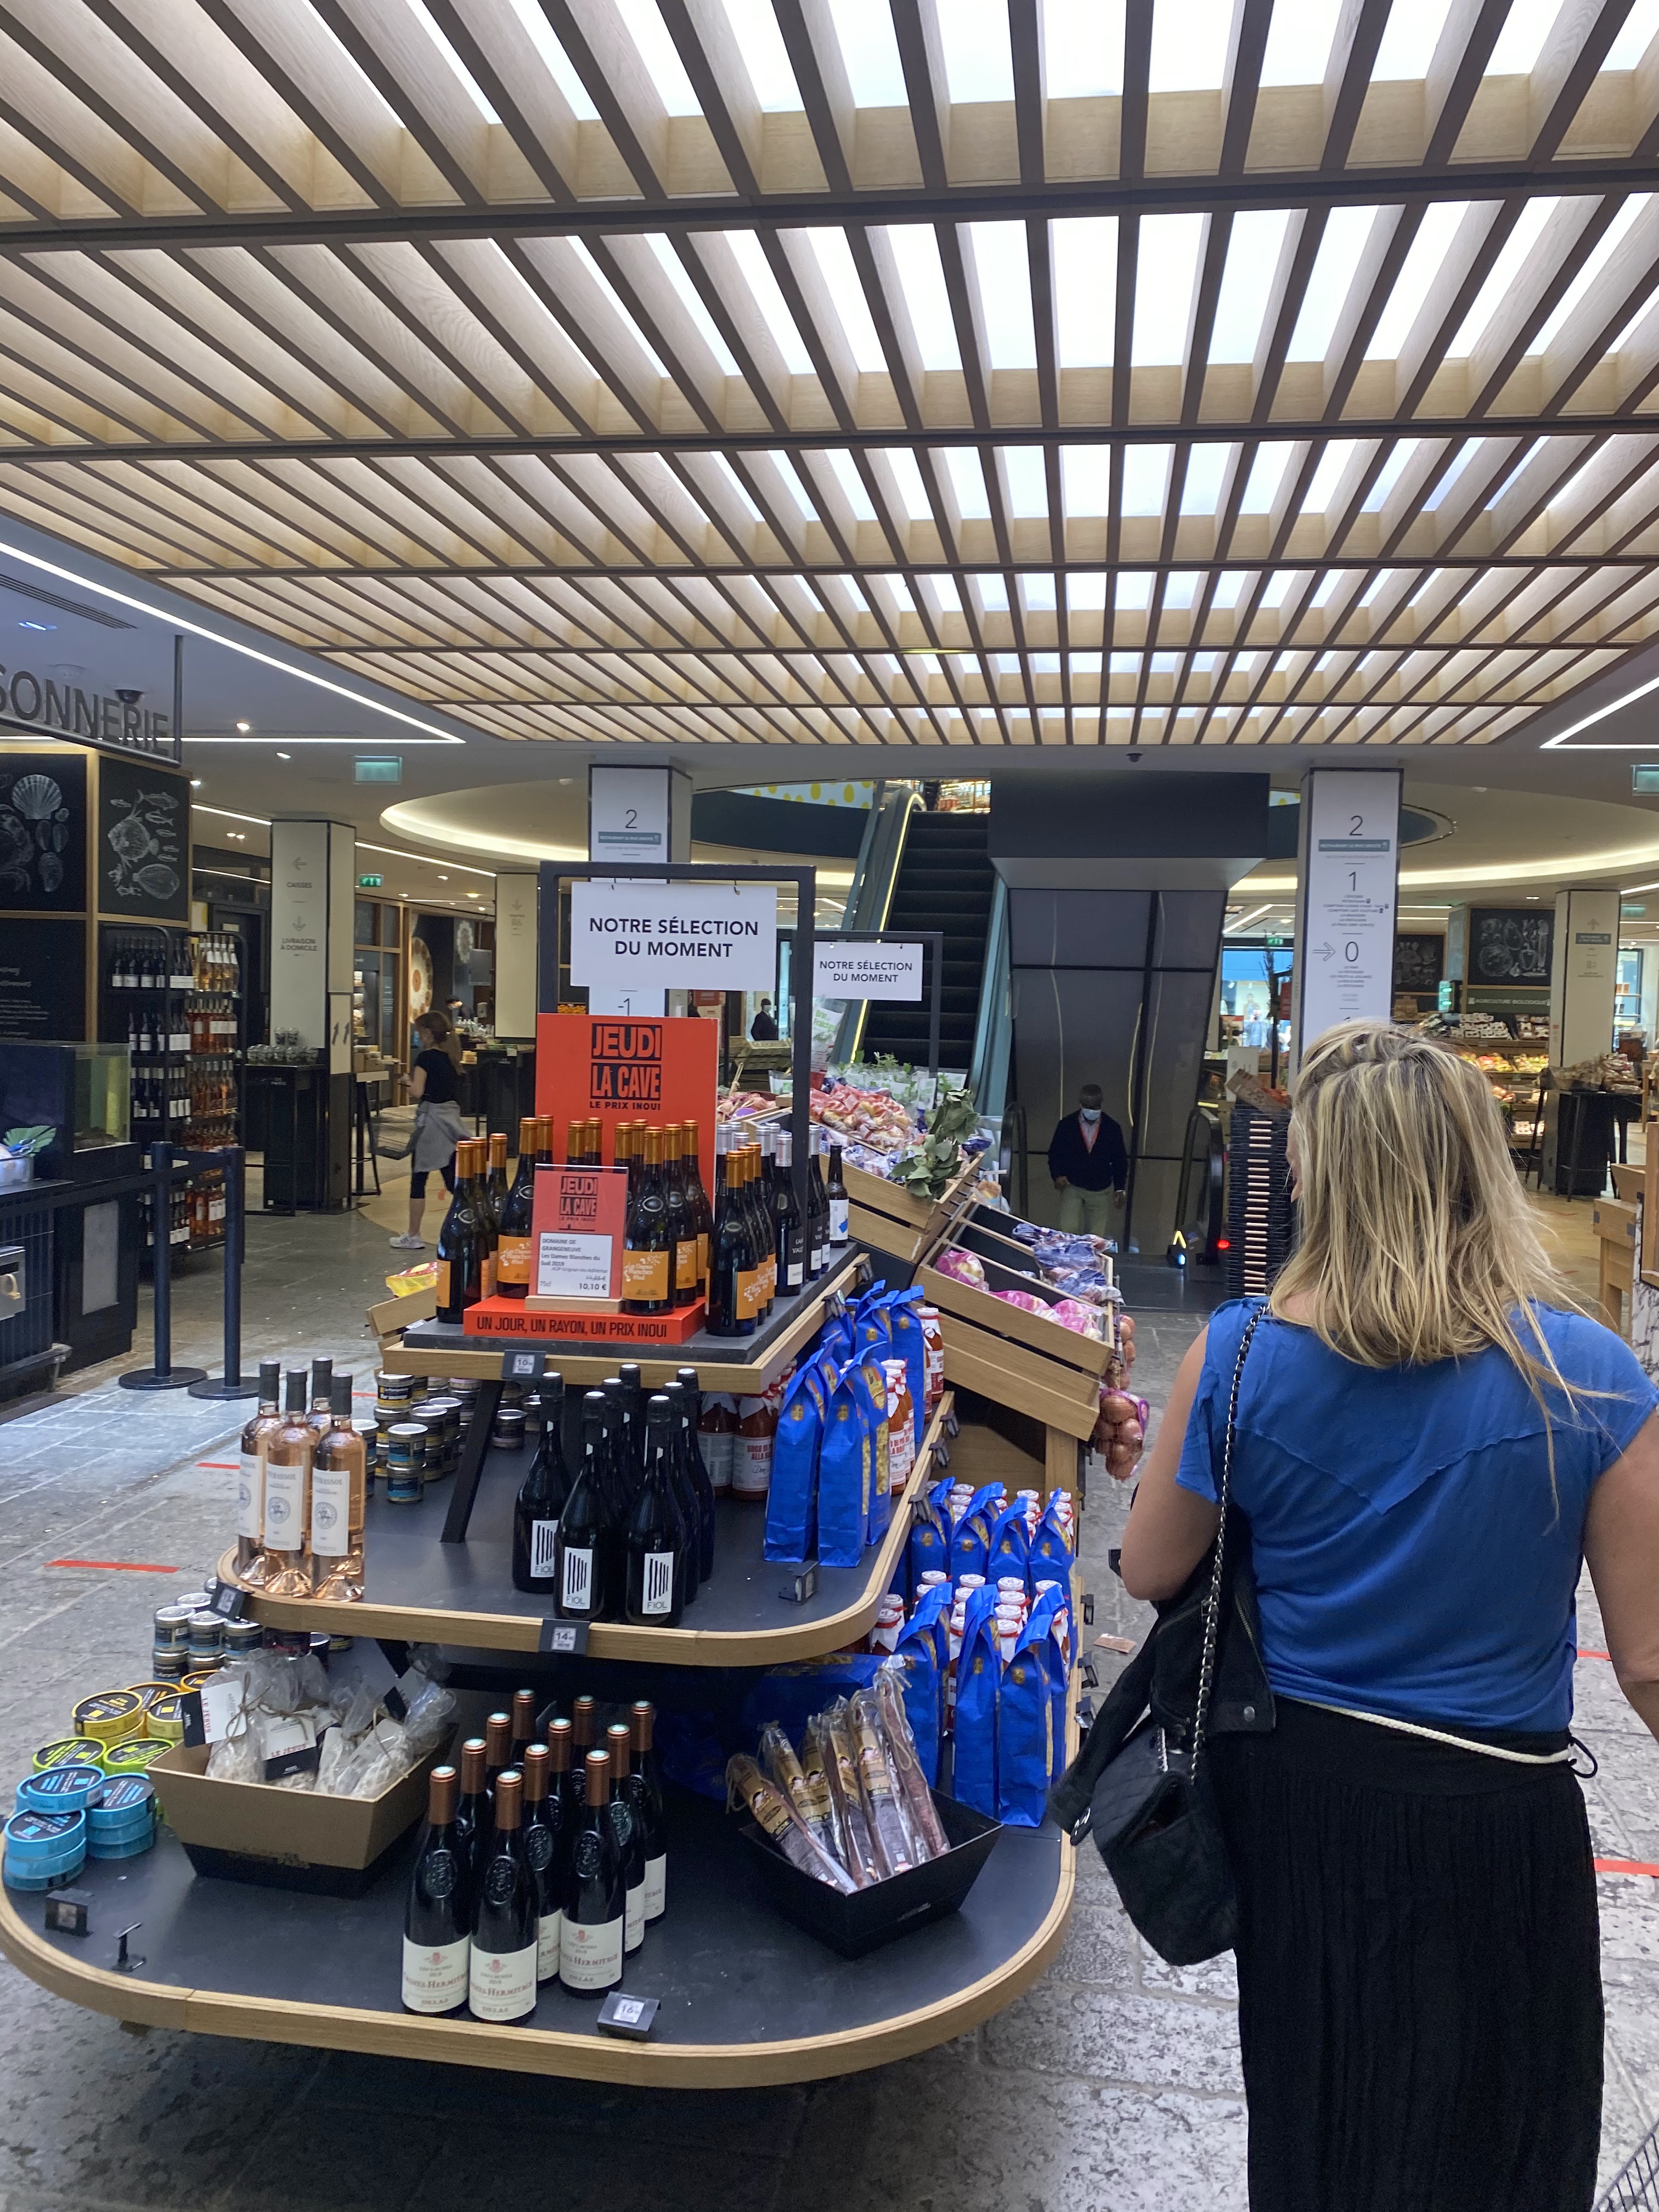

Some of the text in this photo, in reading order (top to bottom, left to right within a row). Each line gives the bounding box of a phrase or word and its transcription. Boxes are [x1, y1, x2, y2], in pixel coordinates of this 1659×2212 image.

[0, 664, 168, 756] ONNERIE
[625, 809, 637, 828] 2
[1349, 815, 1363, 836] 2
[1349, 871, 1356, 891] 1
[590, 917, 758, 935] NOTRE SÉLECTION
[615, 941, 733, 957] DU MOMENT
[1345, 941, 1358, 962] 0
[820, 960, 912, 970] NOTRE SÉLECTION
[851, 974, 898, 982] MOMENT
[592, 1026, 661, 1058] JEUDI
[592, 1065, 660, 1098] LA CAVE
[561, 1177, 597, 1195] JEUDI
[560, 1197, 596, 1216] LA CAVE
[477, 1316, 667, 1338] UN JOUR, UN RAYON, UN PRIX INOUI
[566, 1596, 585, 1604] FIOL
